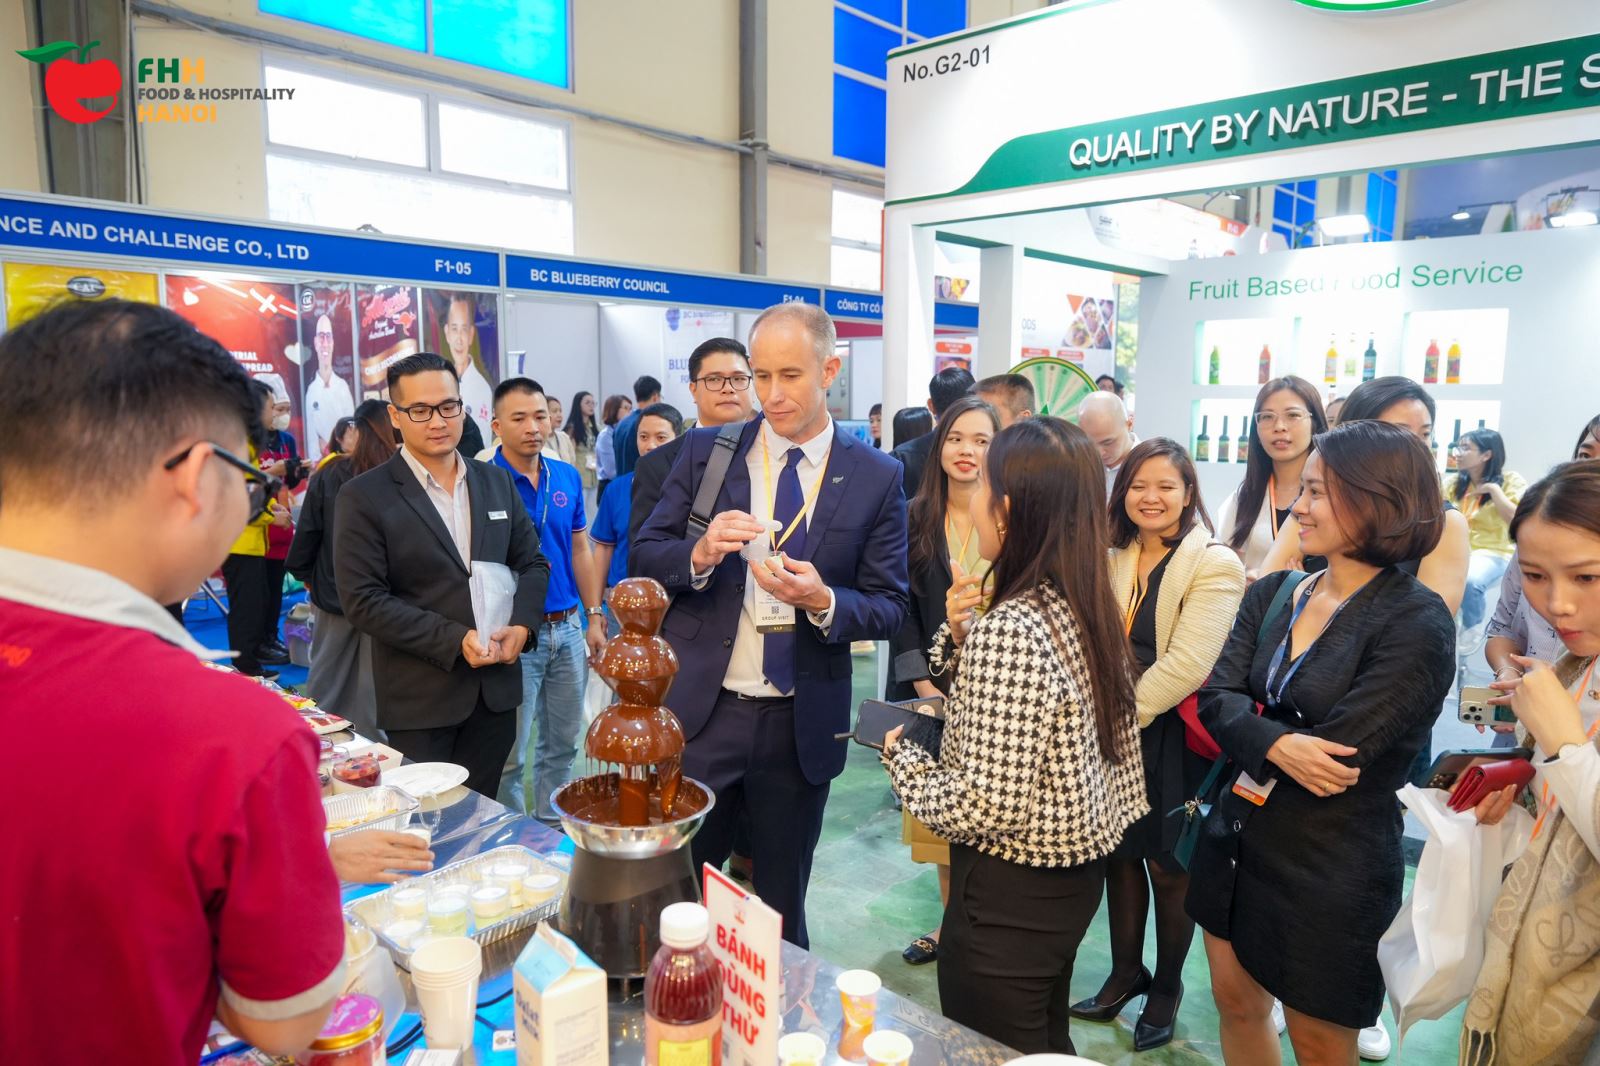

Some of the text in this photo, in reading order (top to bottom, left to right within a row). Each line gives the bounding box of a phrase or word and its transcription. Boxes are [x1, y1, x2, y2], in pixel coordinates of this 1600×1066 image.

[903, 45, 991, 83] No.G2-01
[1069, 118, 1205, 167] QUALITY
[1210, 109, 1260, 145] BY
[1268, 81, 1430, 137] NATURE
[1470, 59, 1565, 105] THE
[49, 220, 98, 241] AND
[103, 226, 230, 253] CHALLENGE
[234, 239, 272, 260] CO.,
[277, 244, 310, 261] LTD
[435, 259, 472, 276] F1-05
[530, 268, 670, 294] BC BLUEBERRY COUNCIL
[1188, 279, 1239, 301] Fruit
[1247, 273, 1324, 297] Based
[1411, 260, 1524, 288] Service
